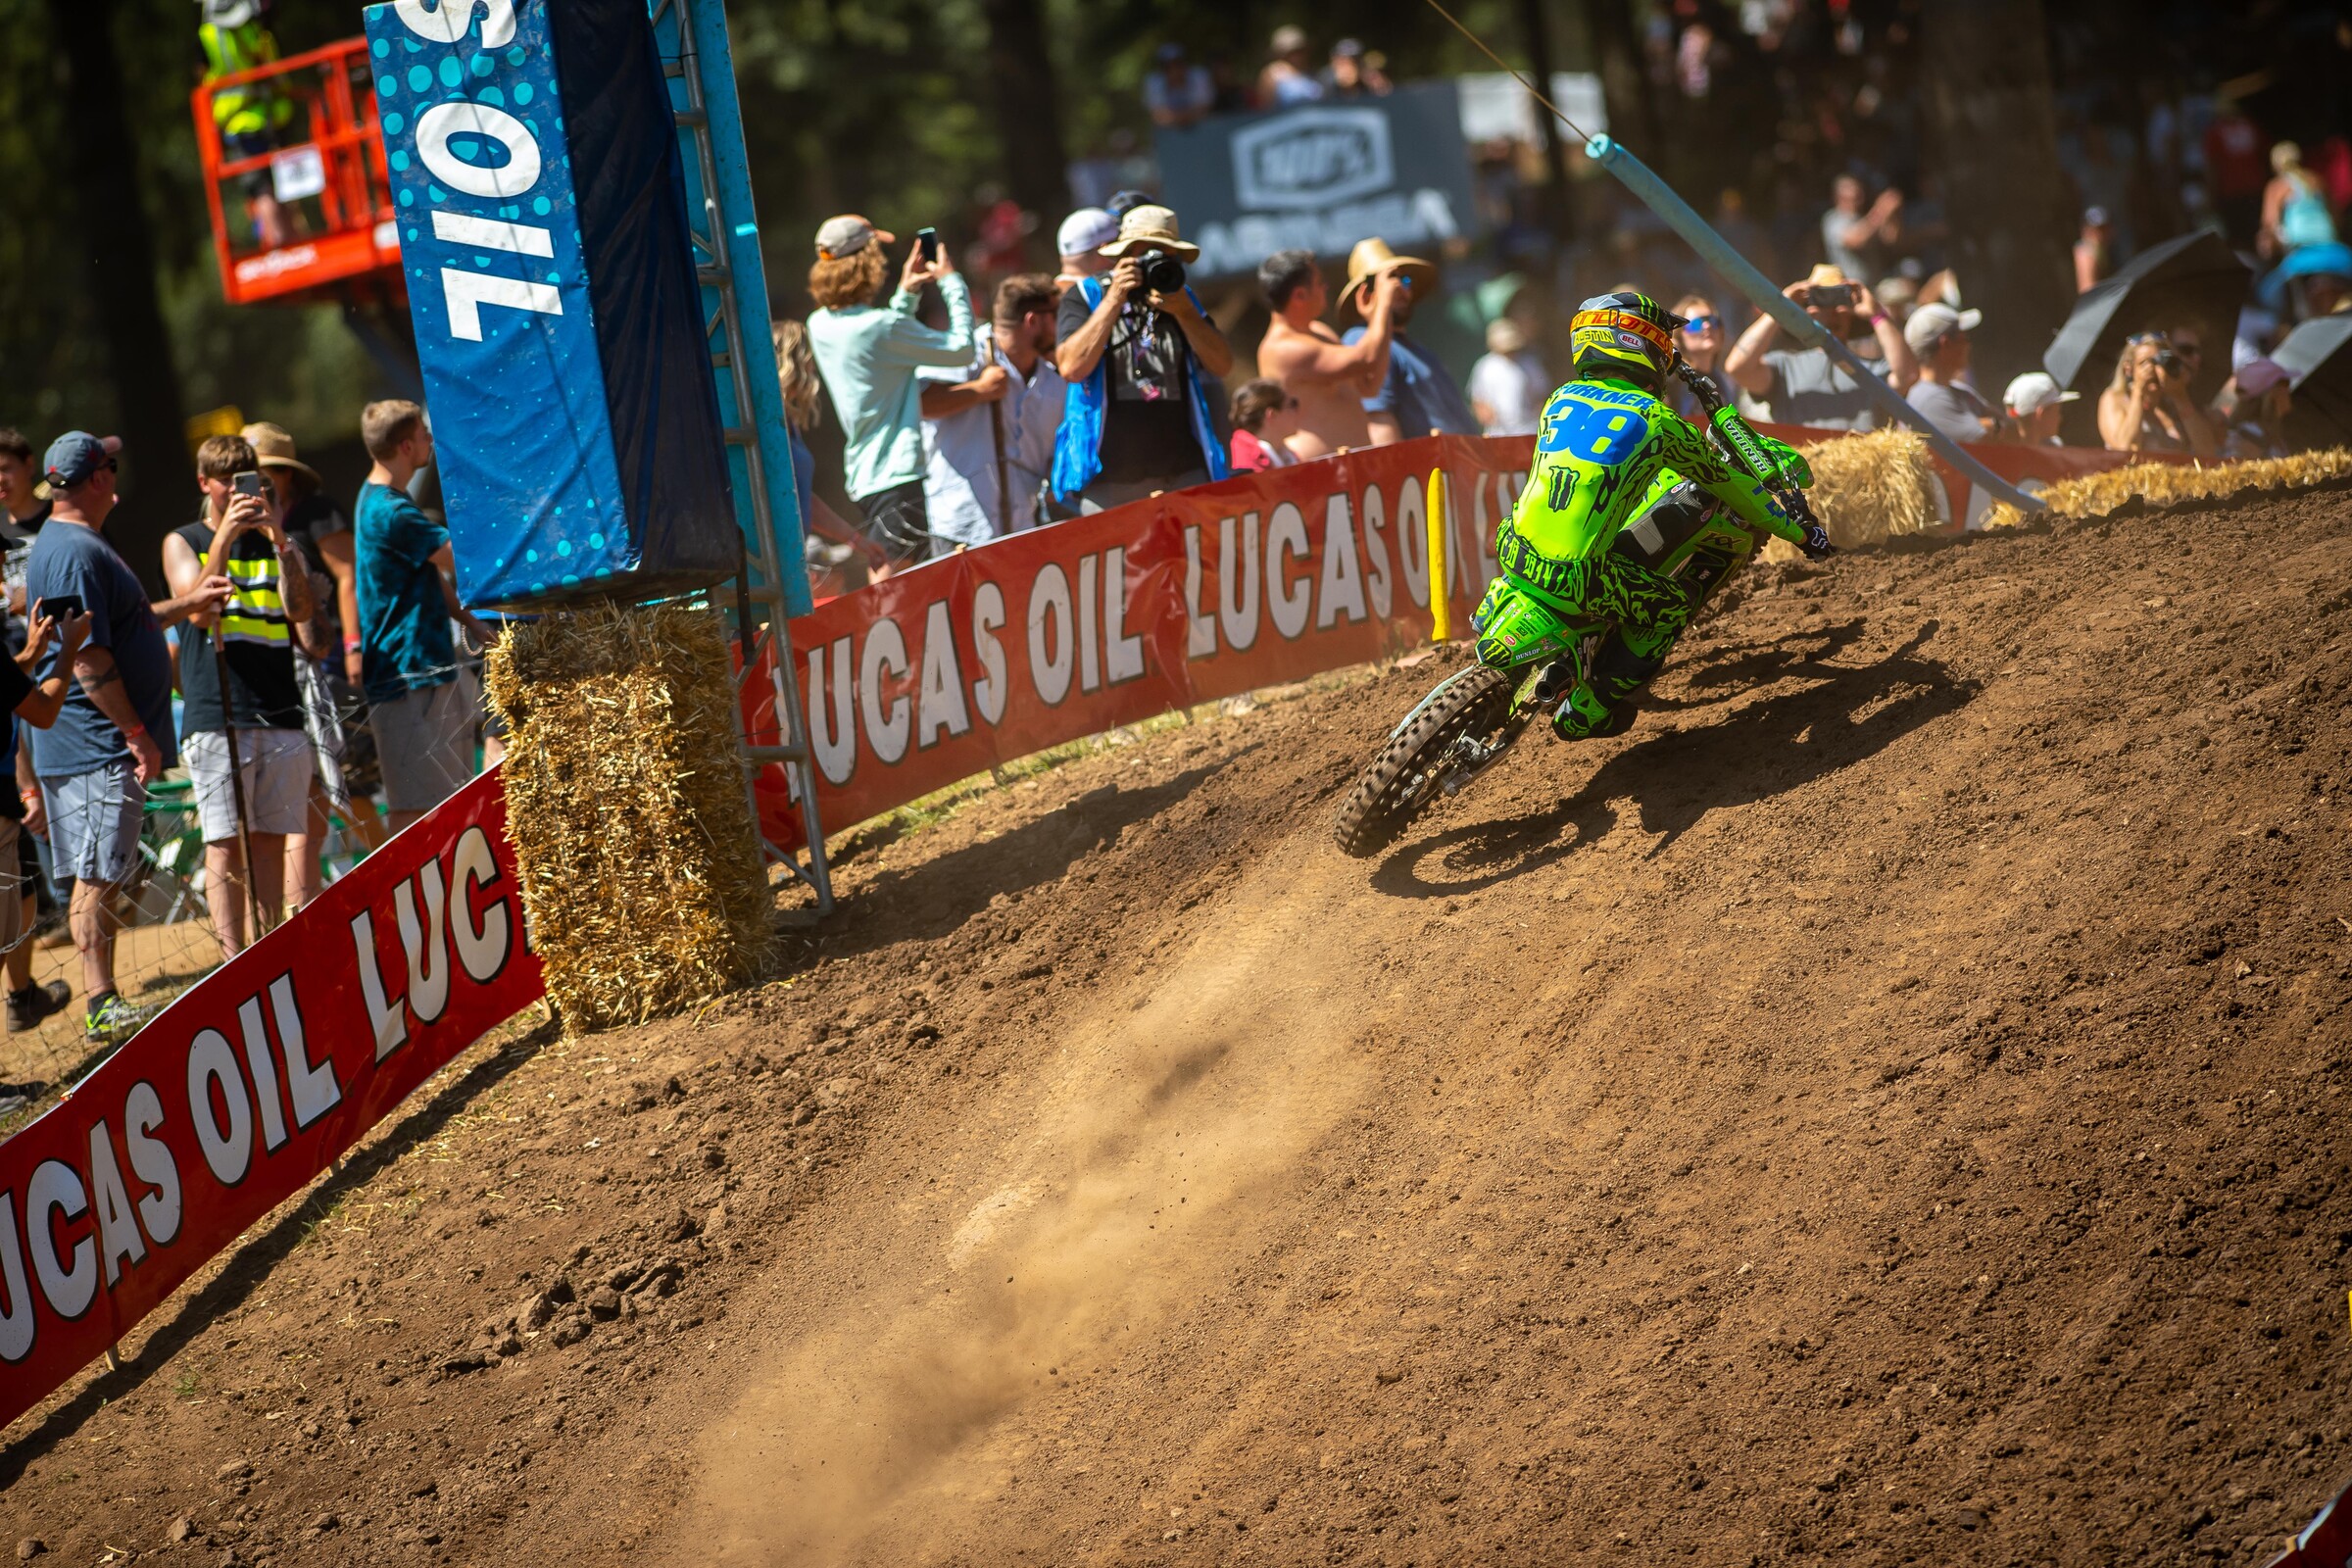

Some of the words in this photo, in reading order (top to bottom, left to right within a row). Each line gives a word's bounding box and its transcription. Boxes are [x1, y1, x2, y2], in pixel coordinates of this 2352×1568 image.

[416, 102, 564, 342] OIL
[1622, 335, 1640, 346] BELL
[1539, 398, 1648, 466] 38
[1027, 546, 1147, 710] OIL
[1184, 475, 1393, 661] LUCAS
[1515, 648, 1541, 661] DUNLOP
[187, 969, 342, 1187] OIL
[350, 825, 534, 1068] LUC
